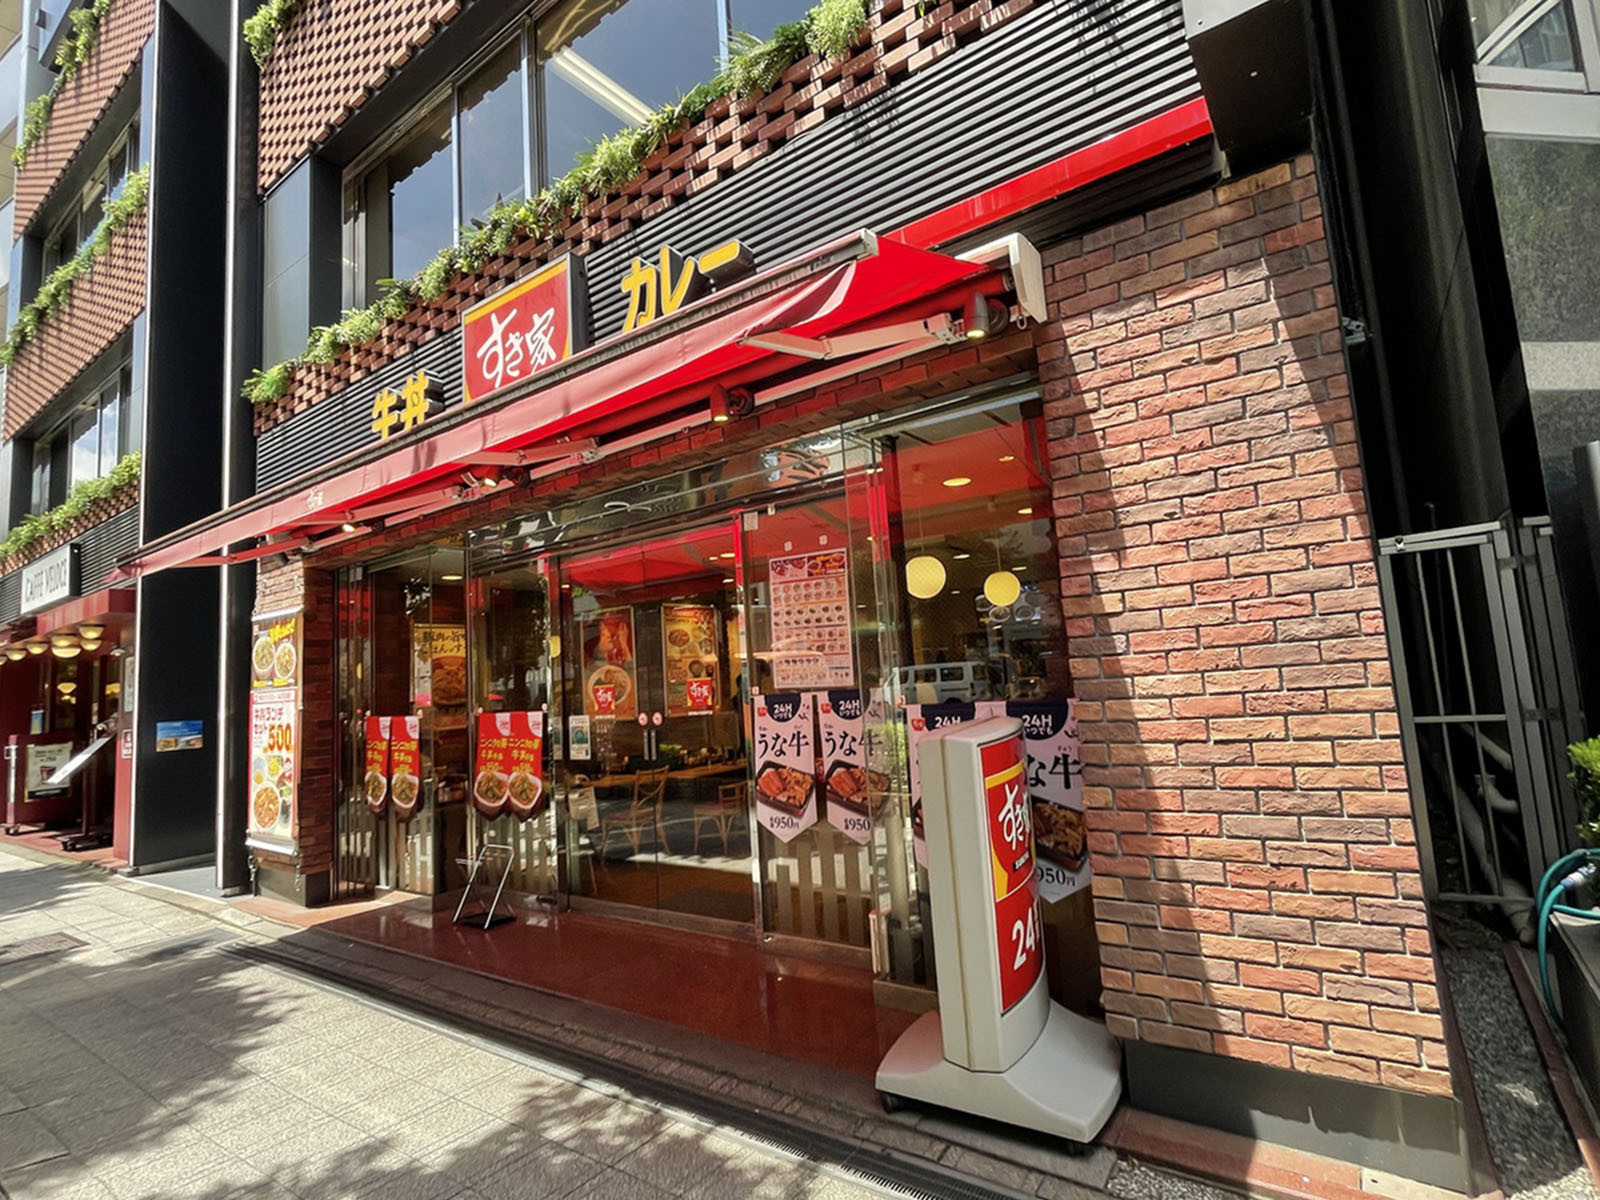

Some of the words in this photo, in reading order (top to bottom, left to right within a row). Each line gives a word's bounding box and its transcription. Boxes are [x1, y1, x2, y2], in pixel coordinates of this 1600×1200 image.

[620, 238, 741, 333] カレー
[476, 306, 557, 388] すき家
[371, 369, 430, 439] 牛丼
[773, 703, 793, 713] 24H
[838, 699, 860, 710] 24H
[934, 716, 962, 728] 24H
[1022, 714, 1053, 727] 24H
[268, 723, 292, 751] 500
[758, 730, 810, 759] うな牛
[824, 729, 883, 758] うな牛
[1027, 753, 1082, 789] な牛
